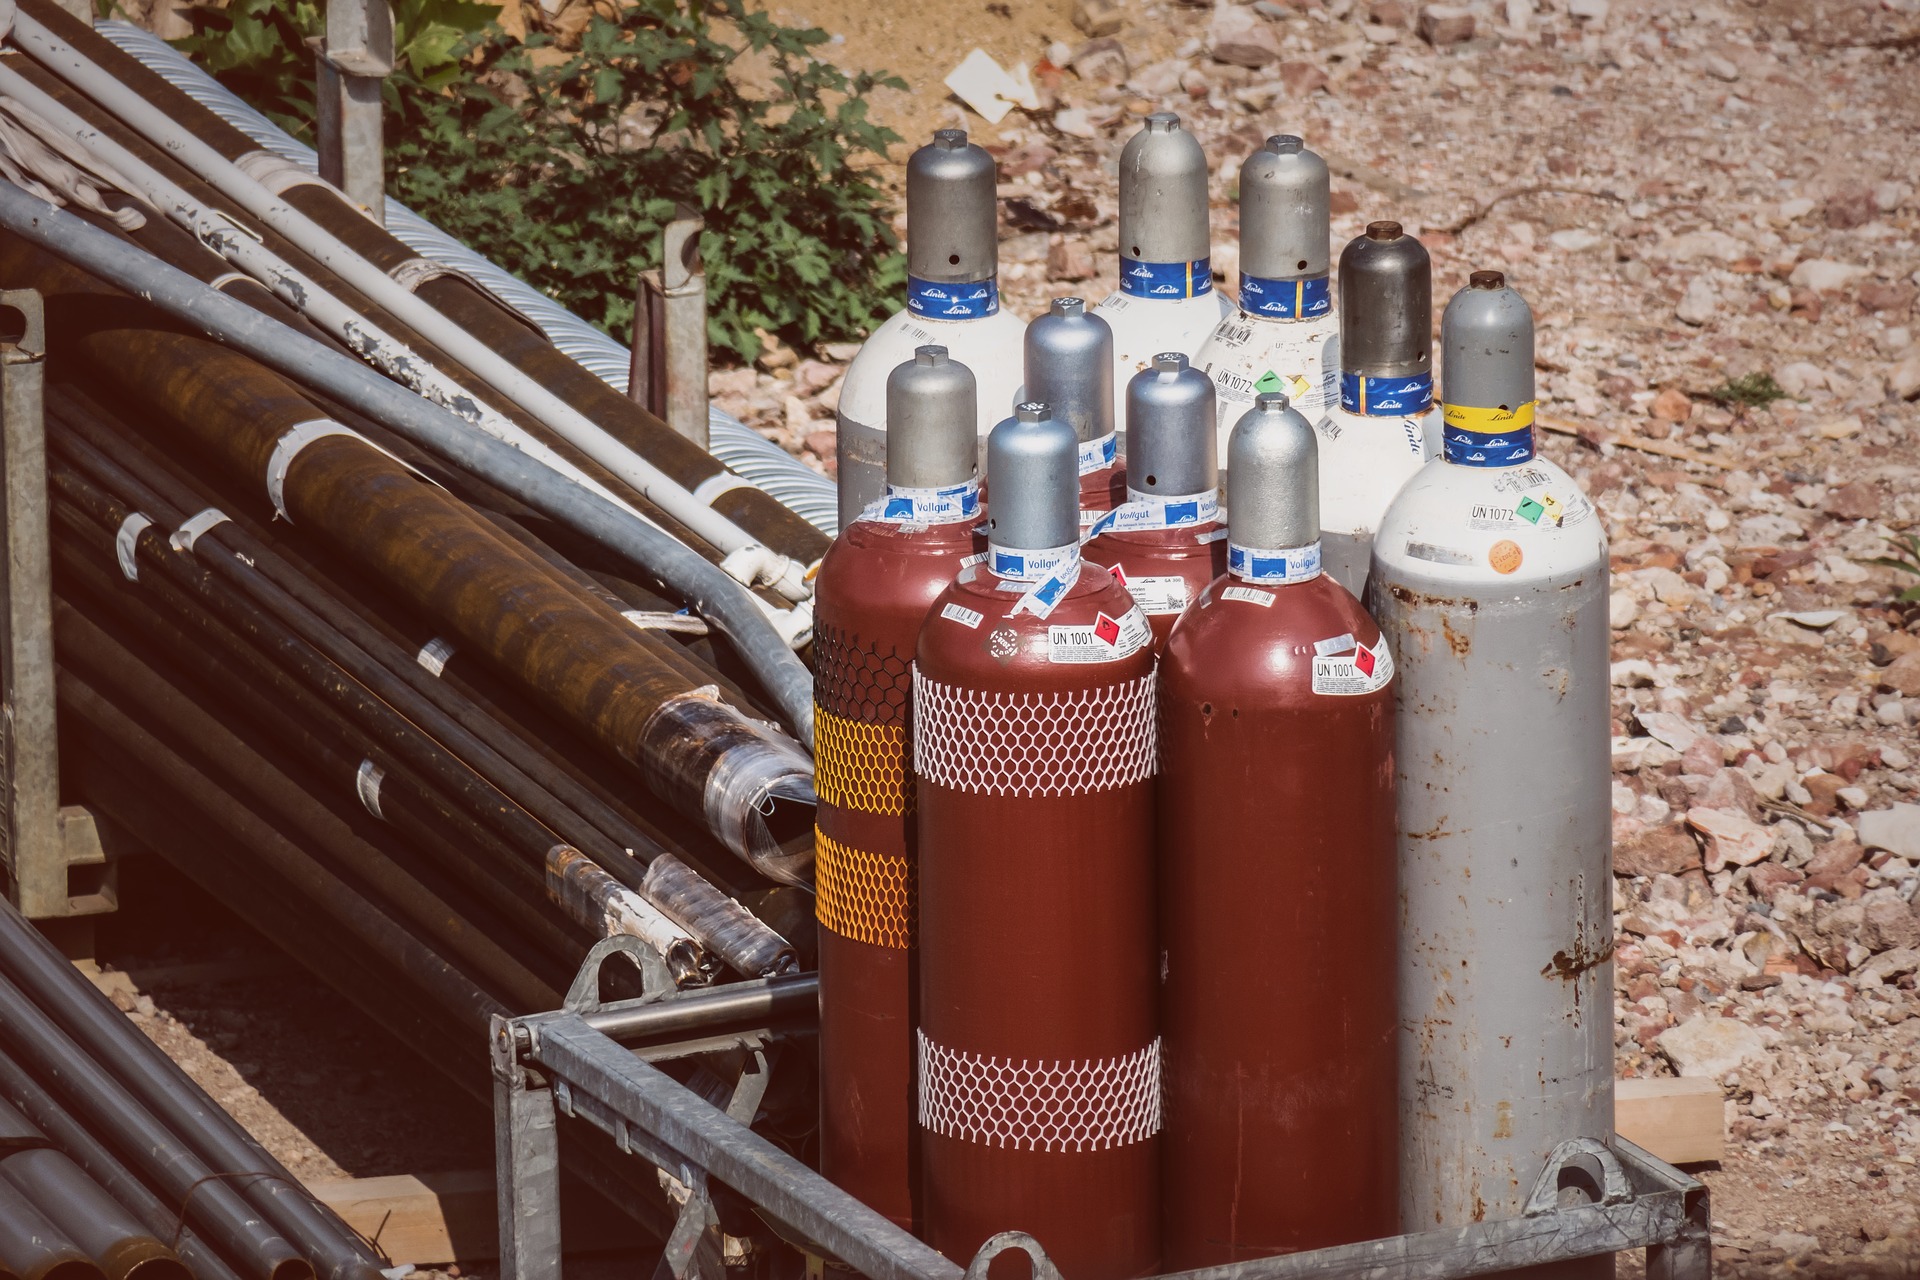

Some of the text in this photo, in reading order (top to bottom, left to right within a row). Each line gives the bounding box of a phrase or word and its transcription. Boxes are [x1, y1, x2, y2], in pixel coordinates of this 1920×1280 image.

[1129, 266, 1154, 279] Linde
[921, 288, 947, 299] Linde
[1150, 284, 1179, 295] Linde
[1244, 282, 1264, 295] Linde
[943, 305, 972, 315] Linde
[1259, 301, 1288, 313] Linde
[1217, 370, 1253, 395] UN 1072
[1398, 382, 1422, 394] Linde
[1373, 399, 1403, 410] Linde
[1446, 409, 1515, 422] Linde Linde
[1452, 434, 1510, 448] Linde Linde
[1466, 447, 1530, 461] Linde Linde
[892, 510, 913, 518] Linde
[917, 503, 951, 514] Vollgut
[1472, 506, 1514, 521] UN 1072
[1120, 510, 1150, 522] Vollgut
[1175, 515, 1197, 523] Linde
[1290, 557, 1317, 570] Vollgut
[1002, 568, 1023, 576] Linde
[1261, 570, 1285, 578] Linde
[1053, 632, 1093, 645] UN 1001
[1317, 664, 1354, 677] UN 1001
